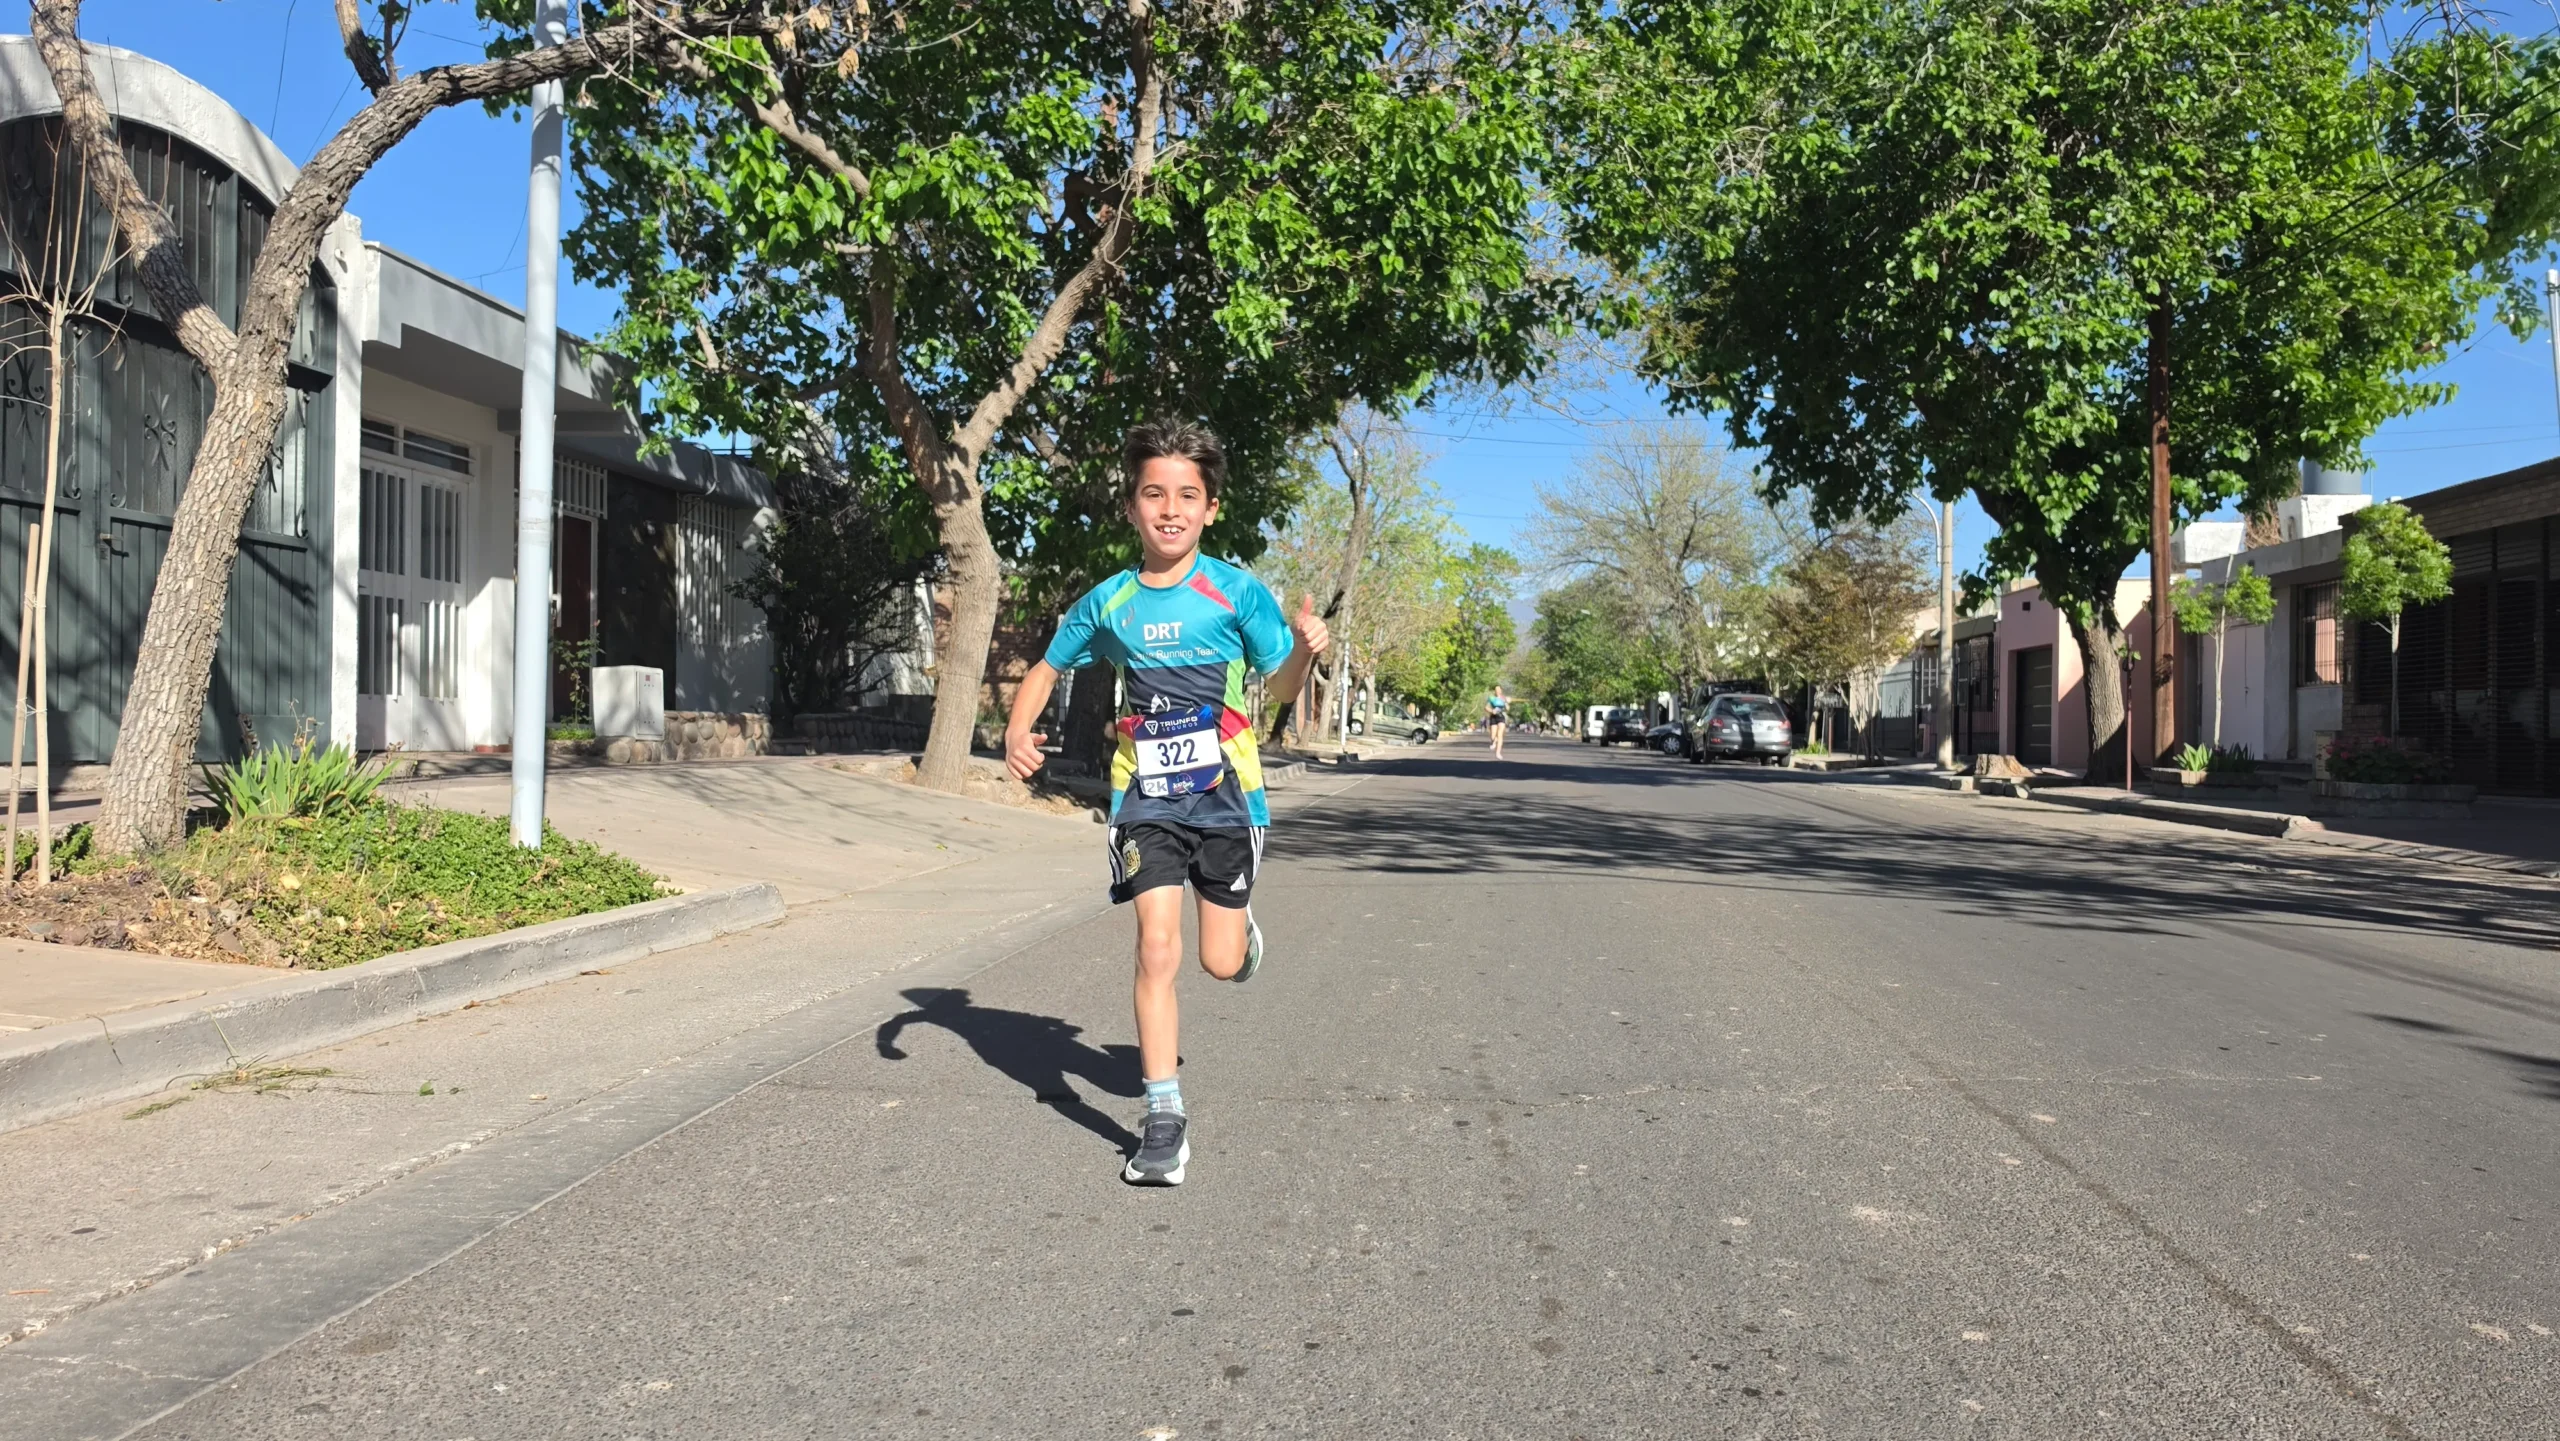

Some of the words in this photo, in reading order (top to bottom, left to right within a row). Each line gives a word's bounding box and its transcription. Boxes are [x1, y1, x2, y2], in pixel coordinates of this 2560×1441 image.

[1144, 622, 1182, 640] DRT
[1156, 649, 1193, 659] Running
[1195, 647, 1219, 656] Team
[1160, 716, 1198, 727] TRIUNFO
[1162, 722, 1198, 732] SEGUROS
[1157, 739, 1198, 767] 322
